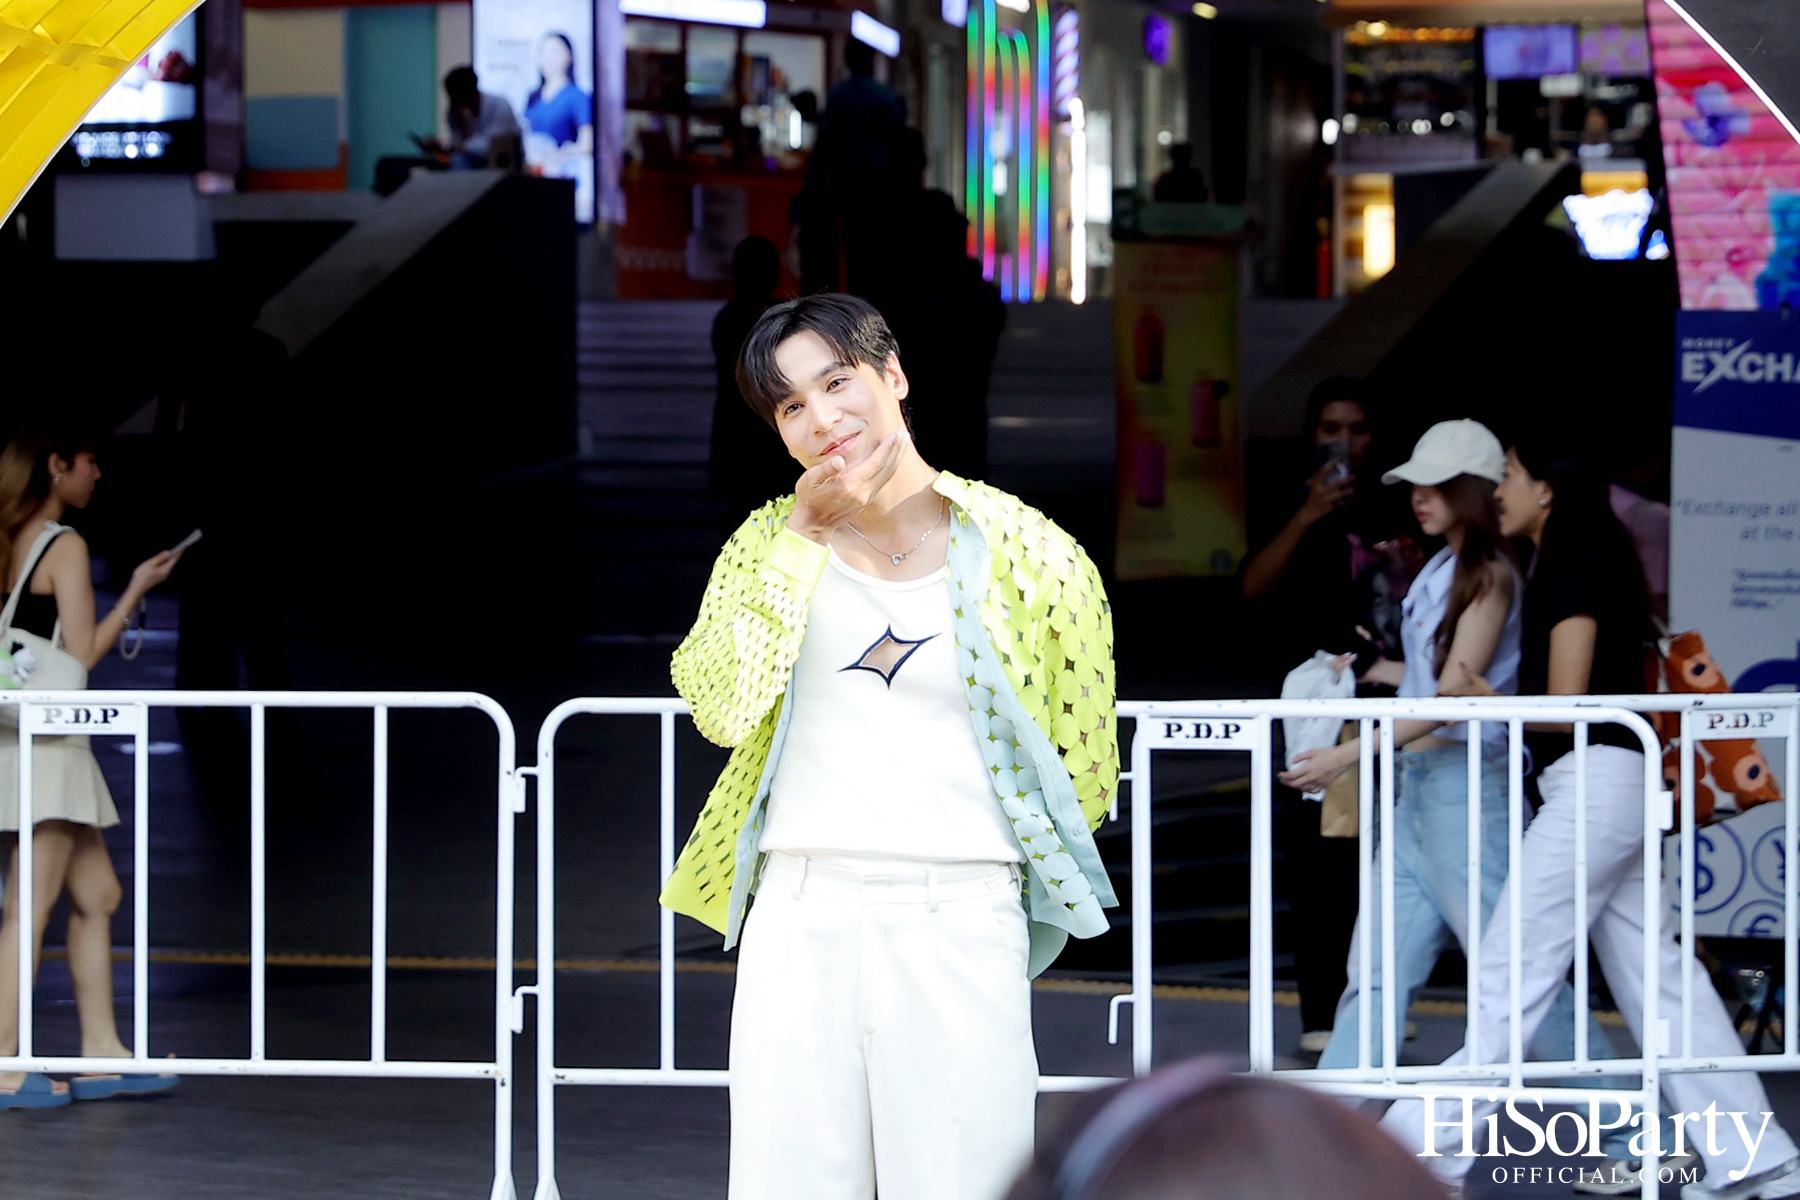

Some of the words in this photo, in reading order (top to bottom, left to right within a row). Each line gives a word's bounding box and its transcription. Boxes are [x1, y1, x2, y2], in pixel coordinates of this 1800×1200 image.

[1681, 339, 1800, 393] EXCH
[43, 707, 119, 724] P.D.P
[1706, 711, 1774, 730] P.D.P
[1163, 722, 1241, 739] P.D.P
